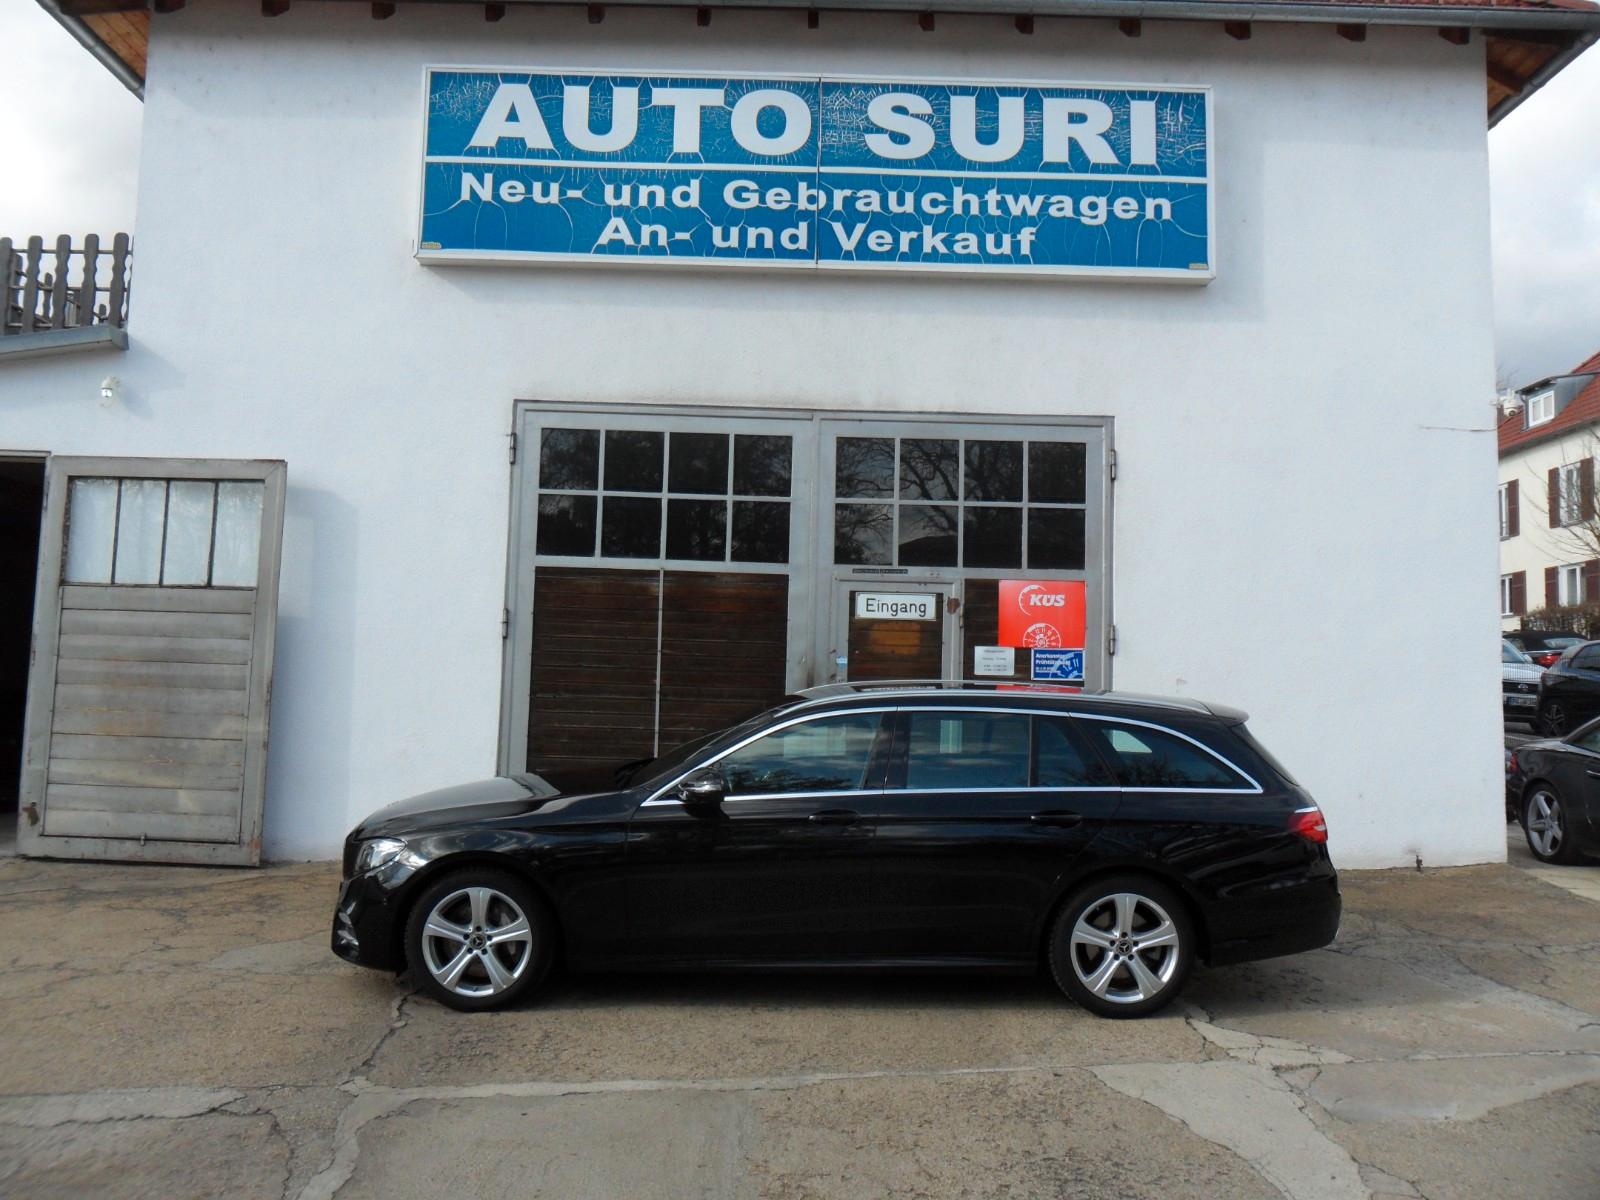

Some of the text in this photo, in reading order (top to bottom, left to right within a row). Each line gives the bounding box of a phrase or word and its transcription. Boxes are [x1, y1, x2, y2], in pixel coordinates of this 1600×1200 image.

[467, 83, 1158, 167] AUTO SURI
[459, 172, 1172, 226] Neu- und Gebrauchtwagen
[597, 216, 1037, 256] An- und Verkauf
[866, 598, 927, 617] Eingang
